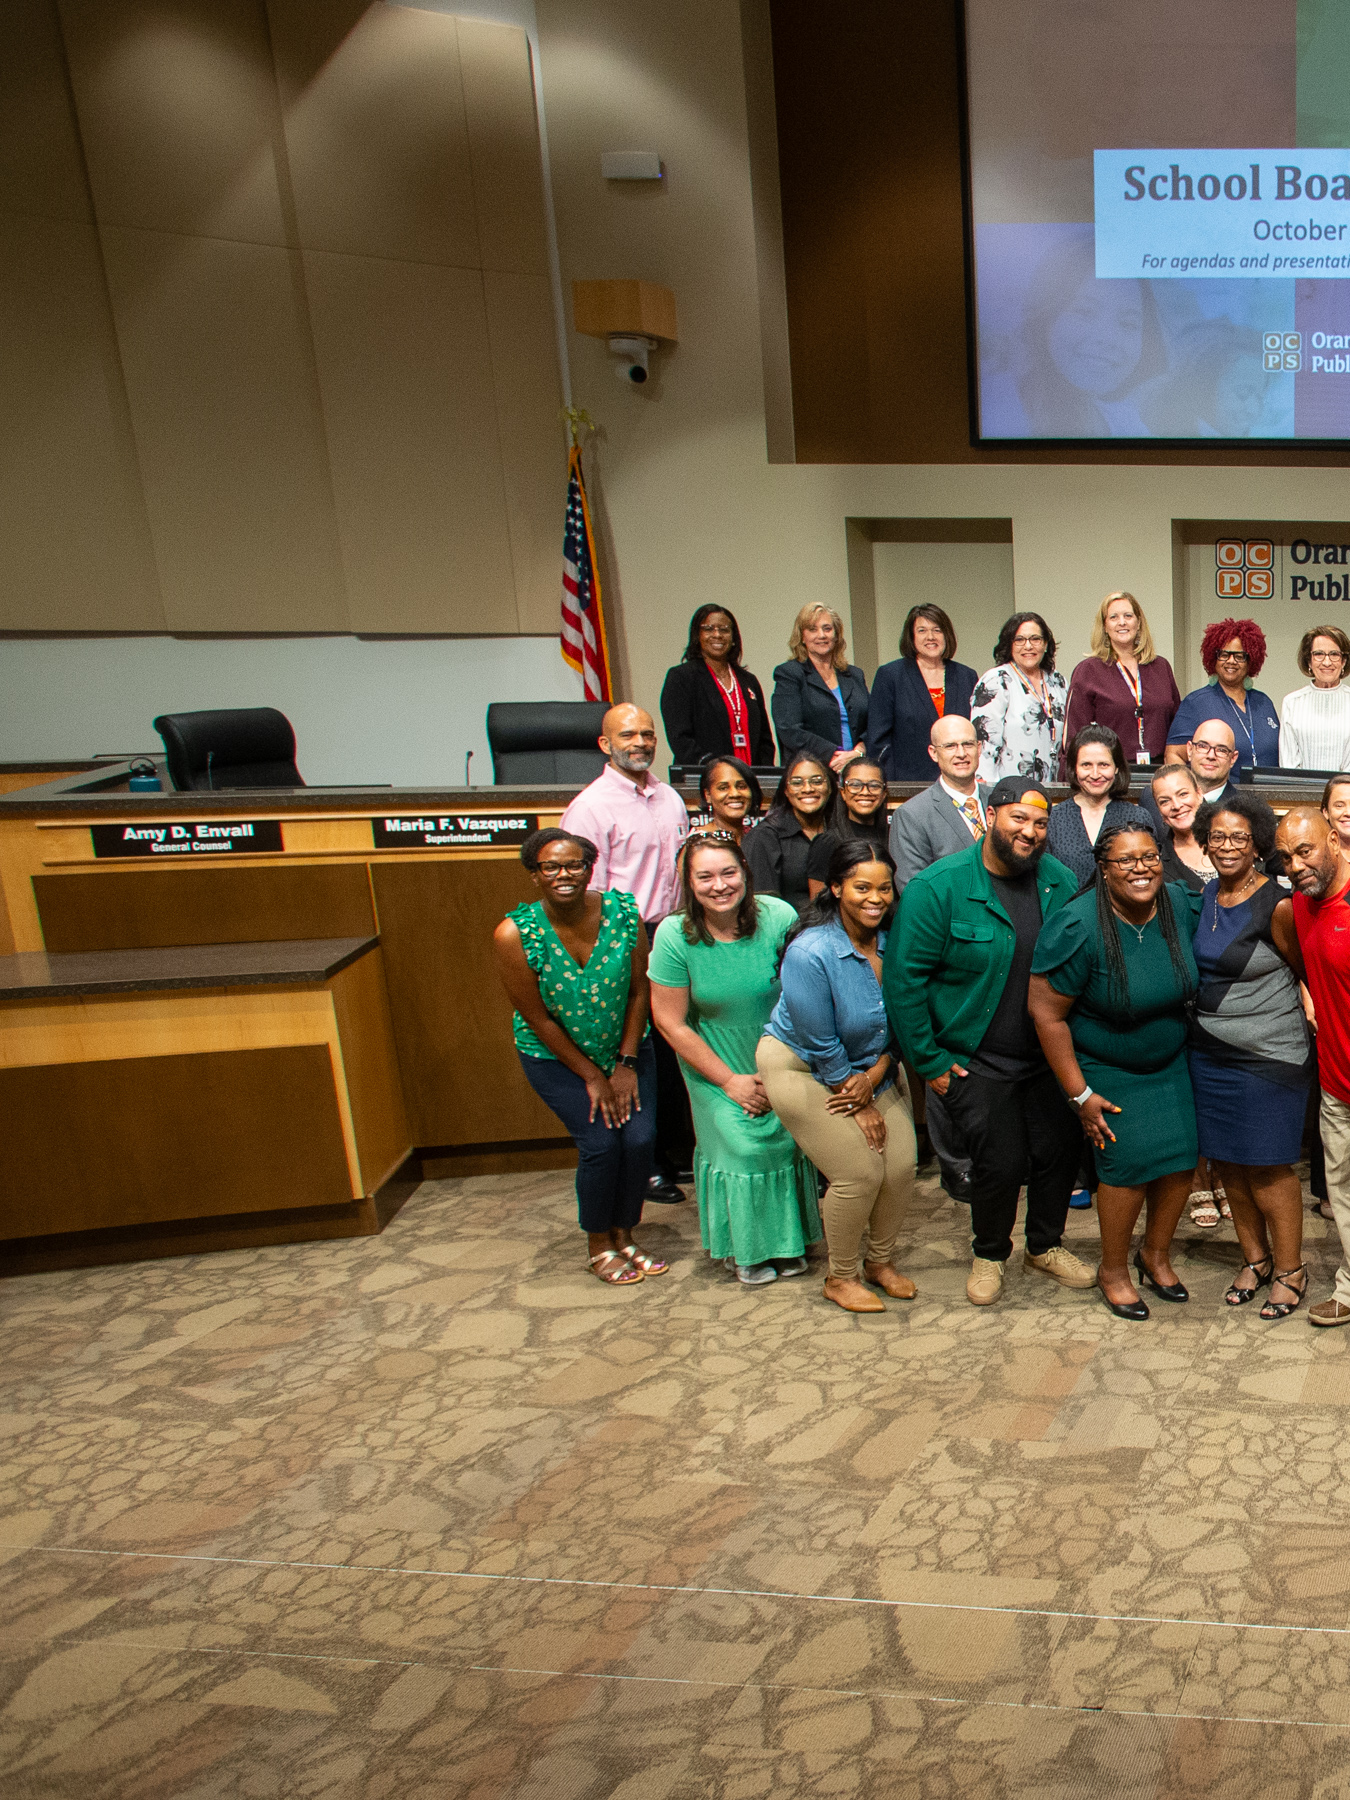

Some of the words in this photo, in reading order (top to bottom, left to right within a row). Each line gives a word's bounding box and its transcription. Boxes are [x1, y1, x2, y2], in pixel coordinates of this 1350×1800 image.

[1124, 164, 1262, 201] School
[1253, 218, 1347, 241] October
[1142, 253, 1167, 269] For
[1170, 253, 1235, 271] agendas
[1240, 253, 1270, 269] and
[123, 827, 167, 842] Amy
[171, 825, 192, 839] D.
[195, 823, 255, 838] Envall
[385, 818, 436, 832] Maria
[439, 818, 455, 831] F.
[457, 817, 528, 832] Vazquez
[151, 842, 191, 852] General
[192, 840, 232, 851] Counsel
[425, 833, 492, 844] Superintendent
